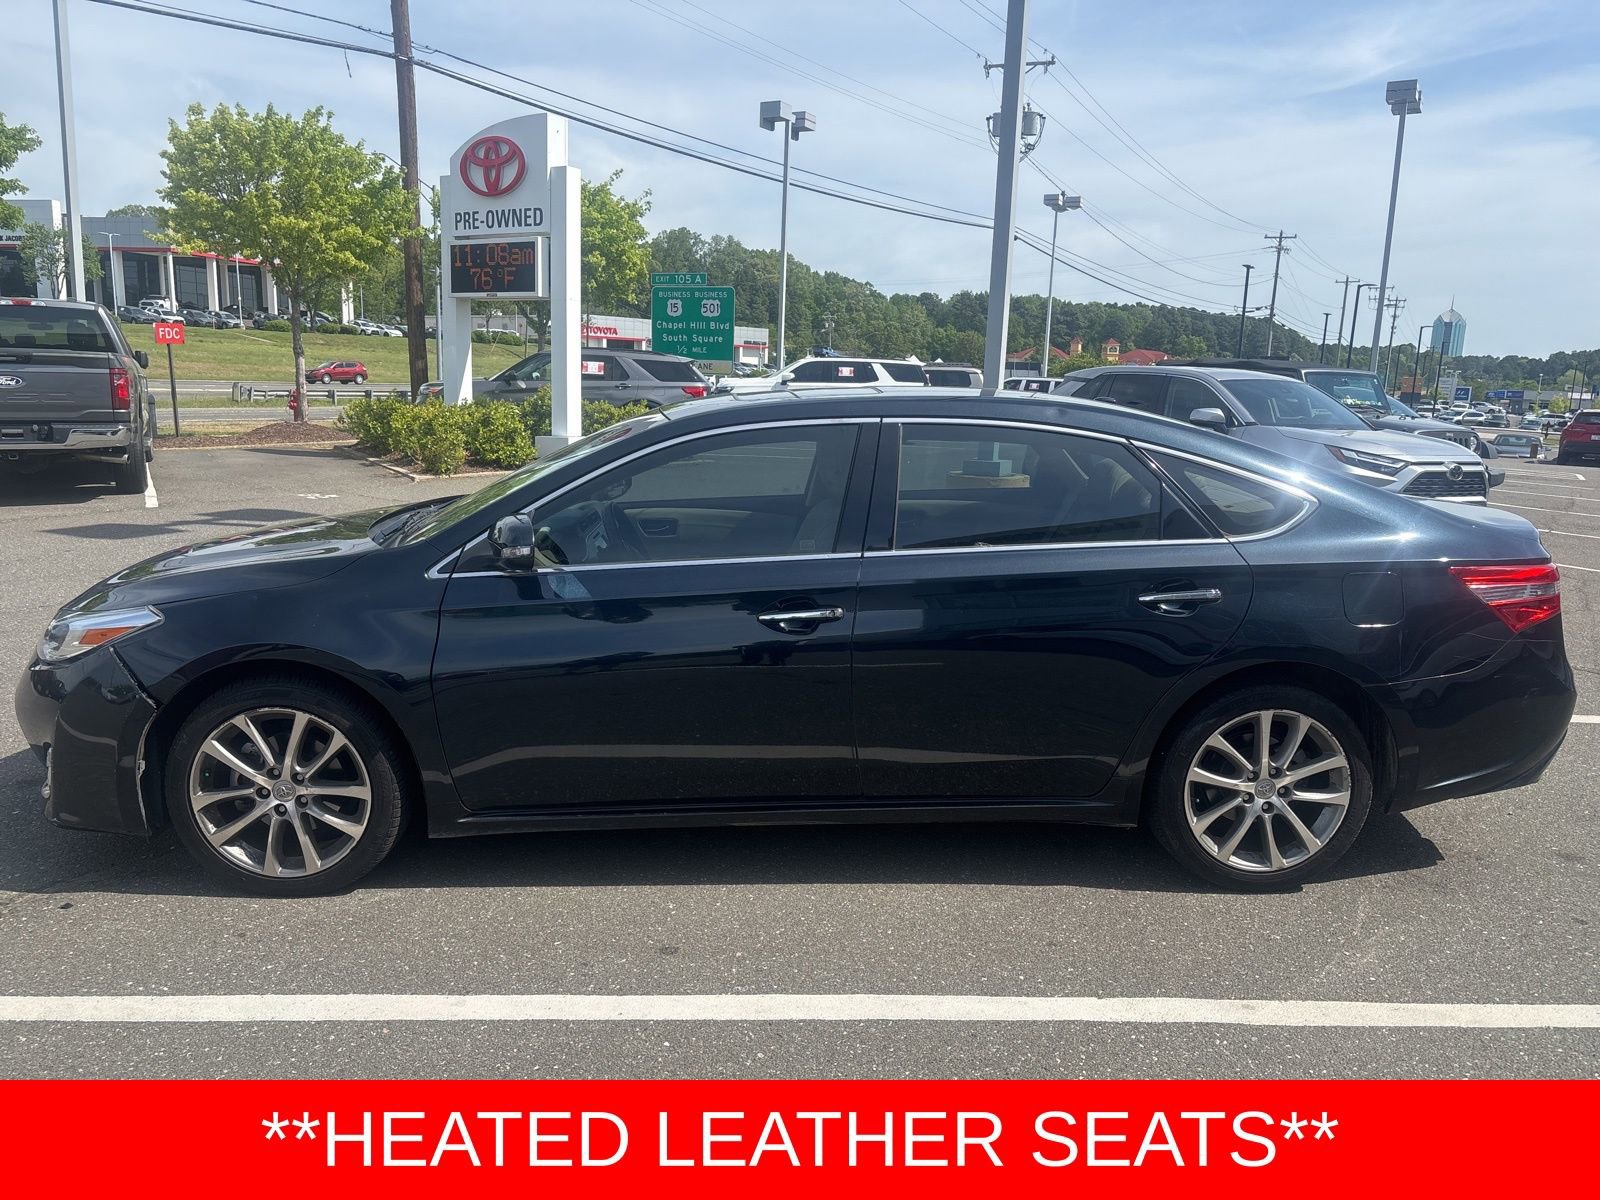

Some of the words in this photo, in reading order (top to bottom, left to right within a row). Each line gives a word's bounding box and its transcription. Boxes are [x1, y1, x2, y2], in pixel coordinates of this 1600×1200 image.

[455, 208, 544, 231] PRE-OWNED
[675, 275, 691, 283] 105
[694, 275, 702, 283] A
[670, 302, 679, 313] 15
[702, 303, 719, 314] 501
[656, 321, 686, 330] Chapel
[690, 321, 706, 329] Hill
[710, 322, 730, 330] Blvd
[159, 327, 181, 339] FDC
[588, 326, 618, 336] TOYOTA
[662, 333, 688, 342] South
[692, 334, 723, 344] Square
[697, 362, 713, 370] ANE
